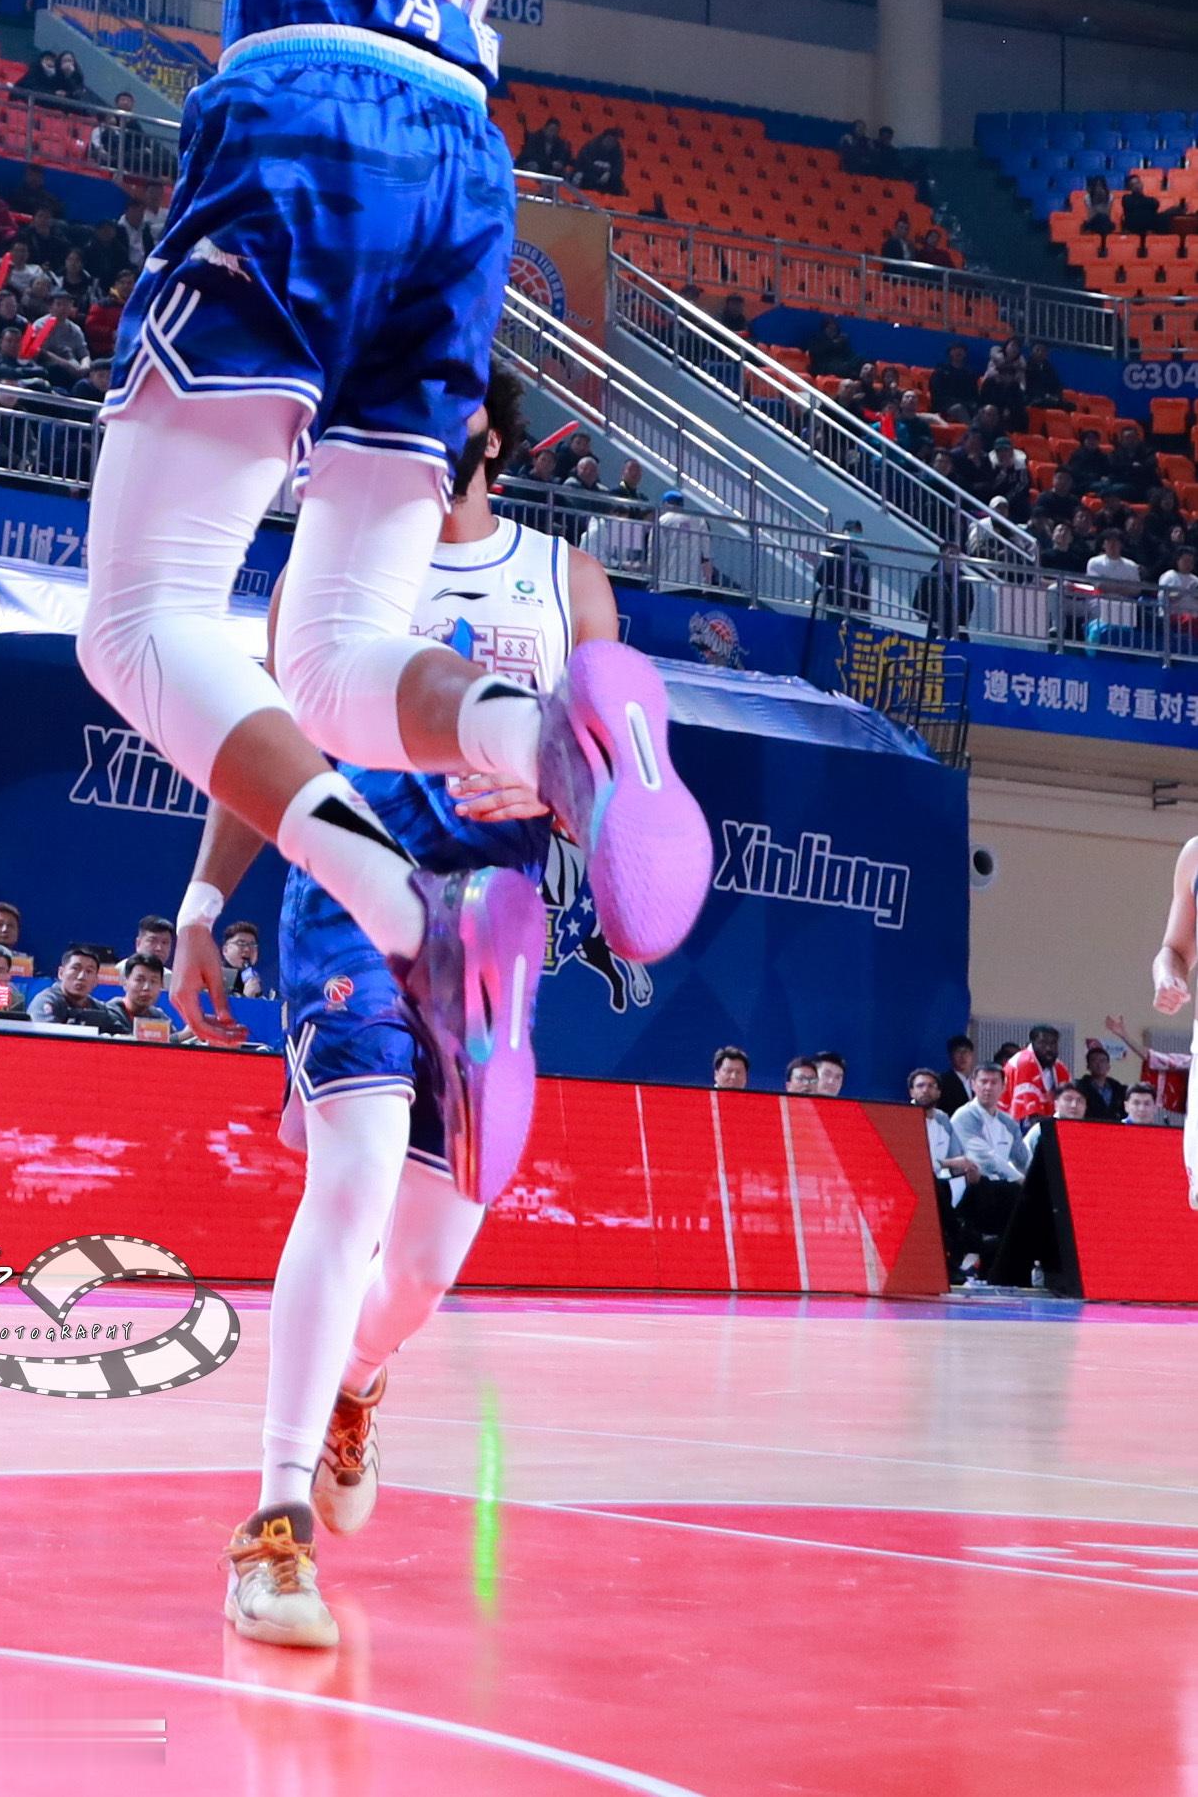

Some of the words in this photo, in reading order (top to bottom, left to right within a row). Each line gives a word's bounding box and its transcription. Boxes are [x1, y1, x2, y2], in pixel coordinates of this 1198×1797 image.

[1122, 363, 1198, 391] C304
[3, 519, 96, 568] 以城之
[983, 668, 1090, 714] 遵守规则
